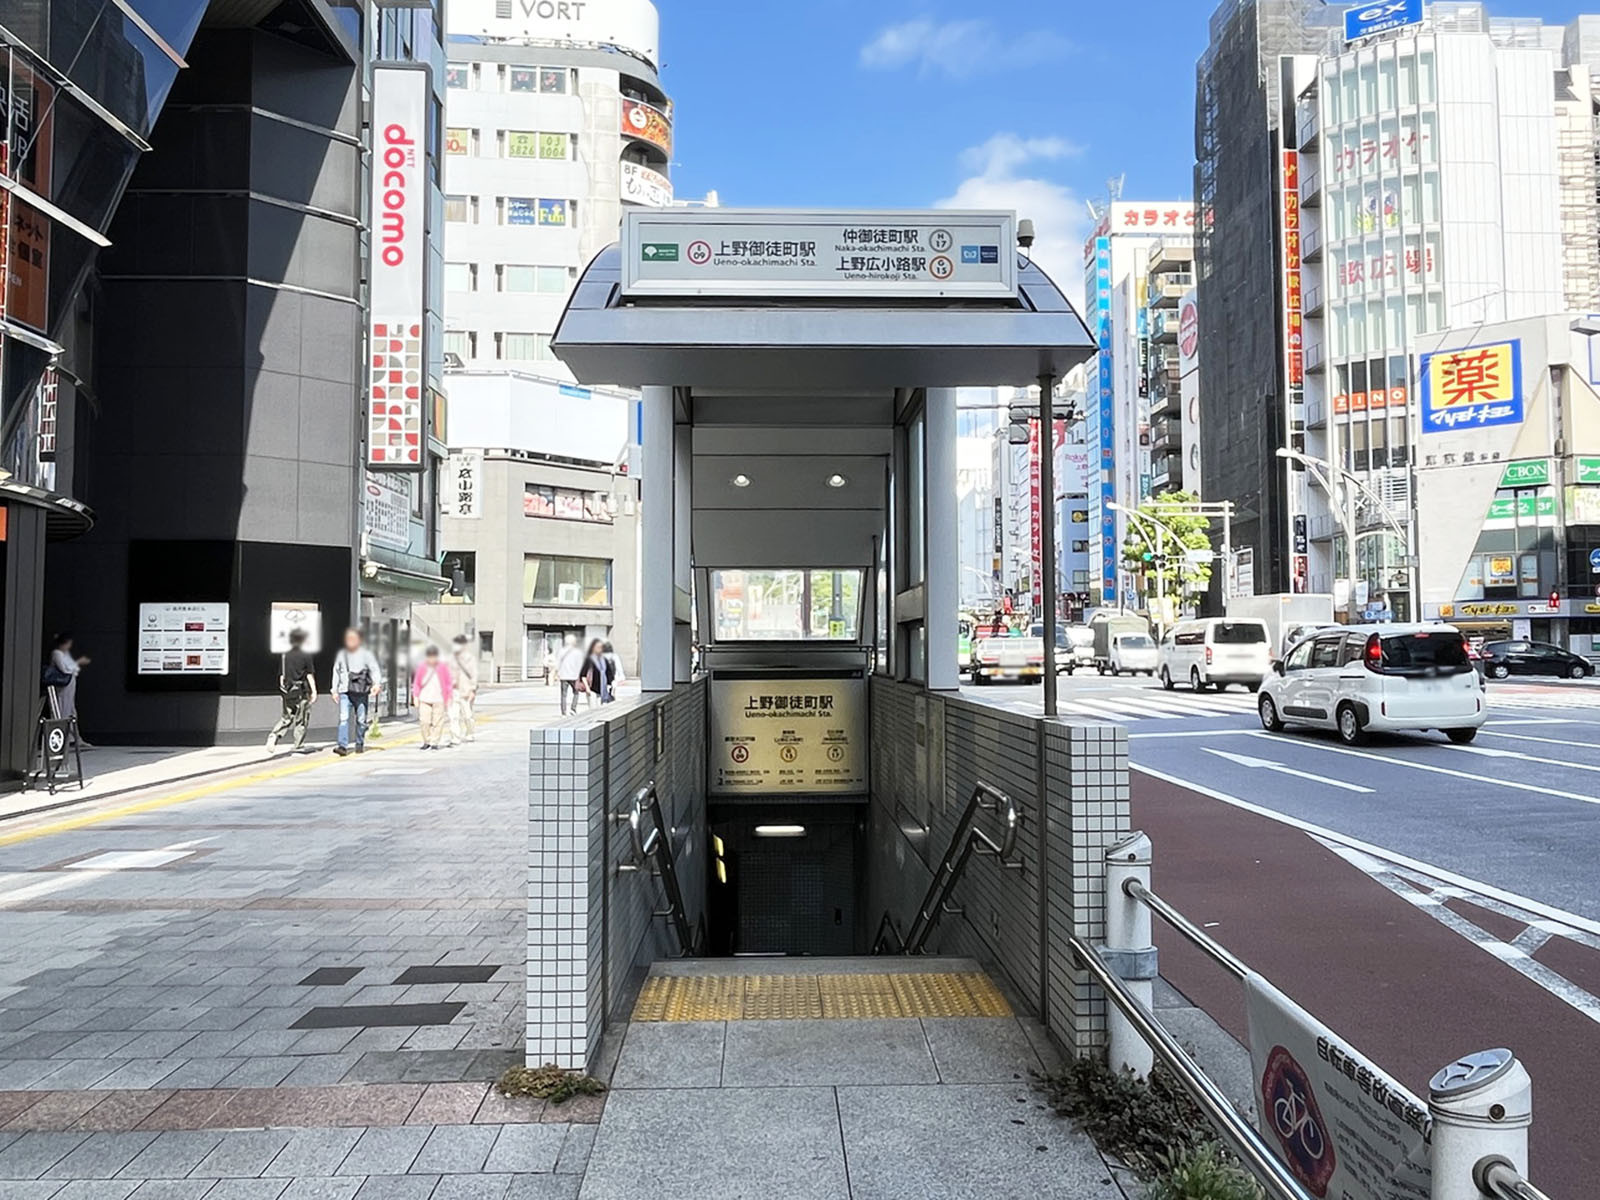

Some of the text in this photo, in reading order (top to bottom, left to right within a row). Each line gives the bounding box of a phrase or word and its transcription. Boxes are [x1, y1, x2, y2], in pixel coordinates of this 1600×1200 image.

[520, 0, 585, 20] VORT
[407, 148, 415, 168] NTT
[1336, 131, 1429, 172] カラオケ
[382, 124, 414, 267] docomo
[843, 229, 919, 244] 仲御徒町駅
[693, 252, 706, 260] 09
[714, 241, 817, 258] 上野御徒町駅
[714, 258, 818, 267] Ueno-okachimachi Sta.
[836, 256, 927, 272] 上野広小路駅
[1340, 247, 1433, 286] 歌広場
[844, 272, 901, 281] Ueno-hirokoji
[1441, 349, 1500, 406] 薬
[744, 695, 834, 711] 上野御徒町駅
